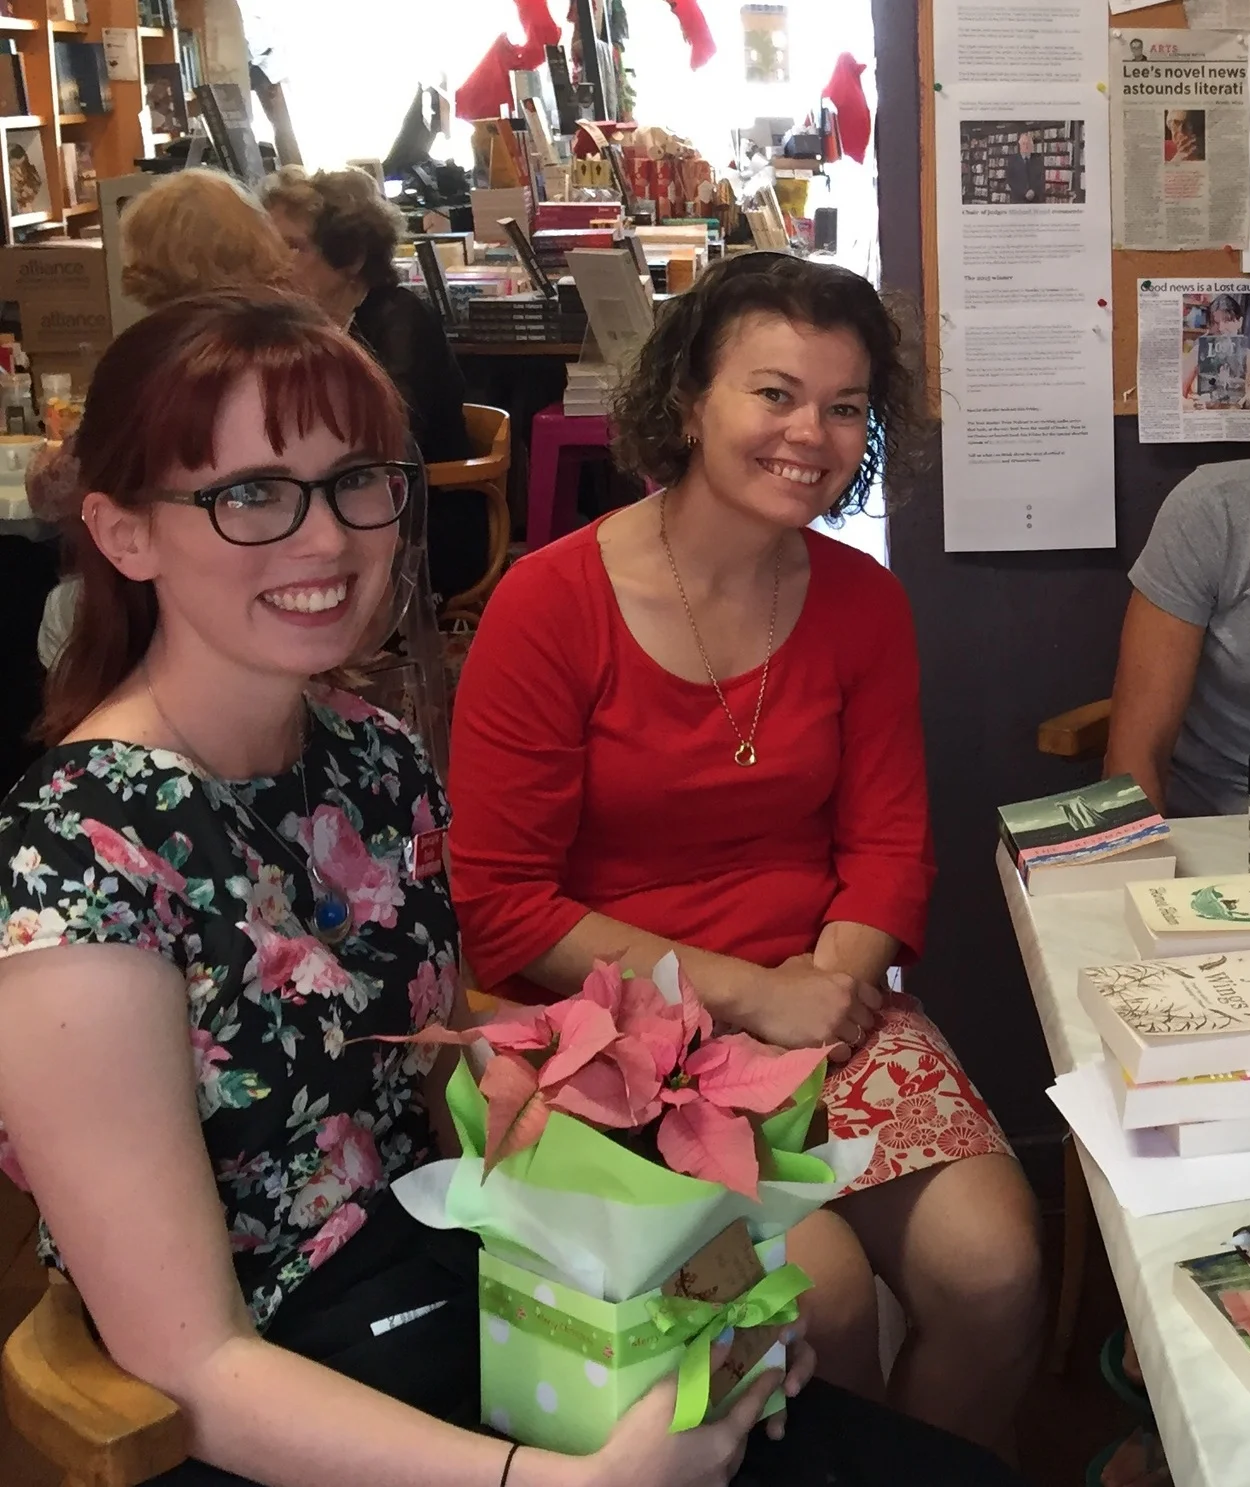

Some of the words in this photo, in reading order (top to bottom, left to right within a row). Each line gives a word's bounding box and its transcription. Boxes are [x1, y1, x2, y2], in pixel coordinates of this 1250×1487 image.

[1150, 44, 1178, 53] ARTS
[1123, 65, 1161, 78] Lee's
[1165, 65, 1205, 78] novel
[1208, 68, 1246, 78] news
[1123, 82, 1191, 95] astounds
[1194, 82, 1243, 95] literati
[20, 259, 84, 275] alliance
[1141, 282, 1167, 292] Good
[1197, 283, 1205, 292] is
[1214, 283, 1235, 292] Lost
[41, 311, 106, 327] alliance
[1204, 971, 1249, 1009] Wings
